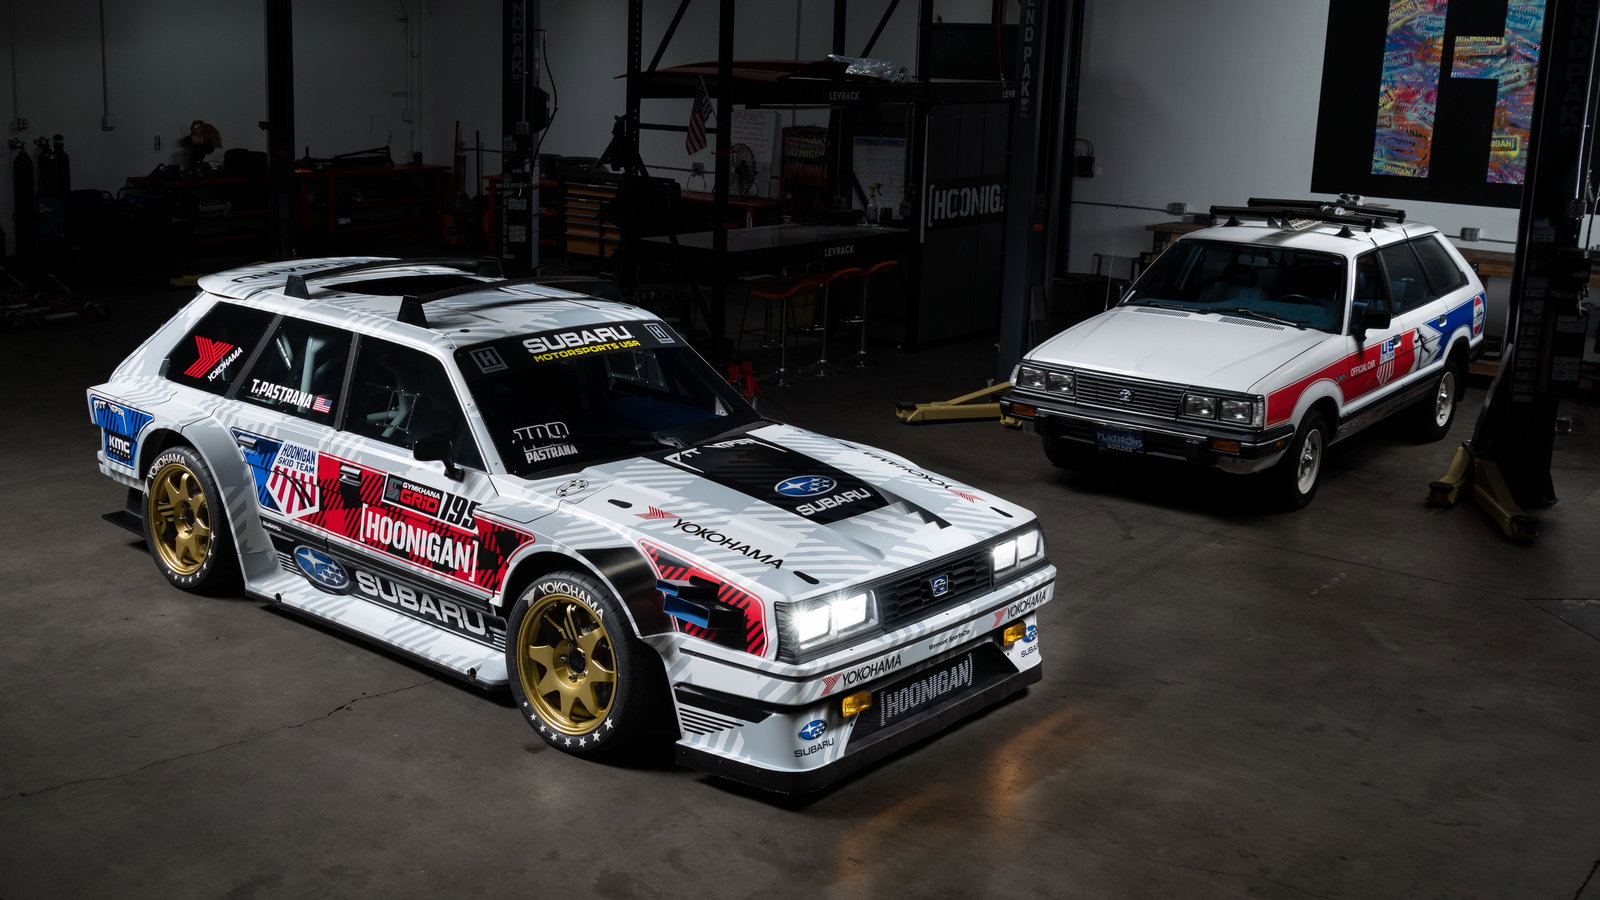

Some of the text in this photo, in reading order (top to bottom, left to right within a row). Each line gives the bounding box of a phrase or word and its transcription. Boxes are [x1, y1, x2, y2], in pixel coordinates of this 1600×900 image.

[829, 90, 860, 101] LEVRACK
[824, 244, 855, 257] LEVRACK
[522, 325, 633, 354] SUBARU
[533, 339, 641, 363] MOTORSPORTS USA
[207, 346, 244, 382] YOKOHAMA
[1350, 360, 1376, 377] OFFICIAL CAR
[147, 452, 187, 480] YOKOHAMA
[277, 456, 315, 475] SKID TEAM
[280, 443, 317, 466] HOONIGAN
[525, 444, 579, 464] PASTRANA
[402, 481, 441, 500] GYMKHANA
[795, 486, 872, 517] SUBARU
[673, 517, 785, 570] YOKOHAMA
[355, 570, 490, 637] SUBARU
[537, 581, 605, 621] YOKOHAMA
[1006, 589, 1047, 620] YOKOHAMA
[842, 654, 902, 687] YOKOHAMA
[793, 737, 835, 758] SUBARU
